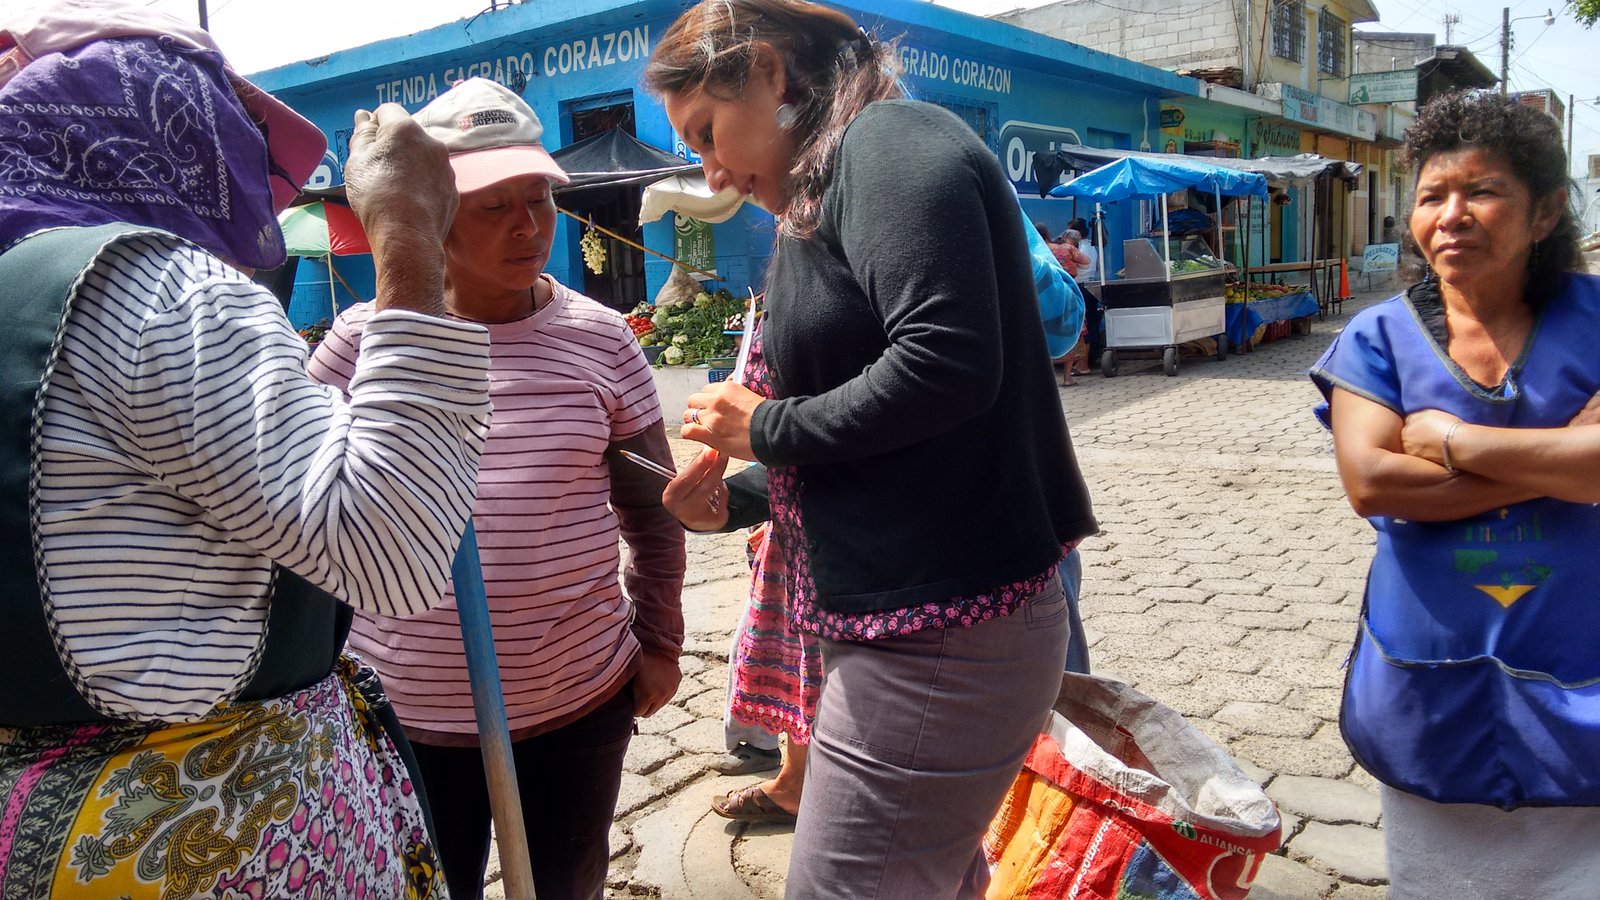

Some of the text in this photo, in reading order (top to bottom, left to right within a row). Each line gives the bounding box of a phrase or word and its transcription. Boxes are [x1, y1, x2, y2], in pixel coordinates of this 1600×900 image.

[376, 72, 438, 106] TIENDA
[544, 25, 649, 77] CORAZON
[953, 58, 1011, 94] CORAZON
[1200, 833, 1252, 855] ALIANSA
